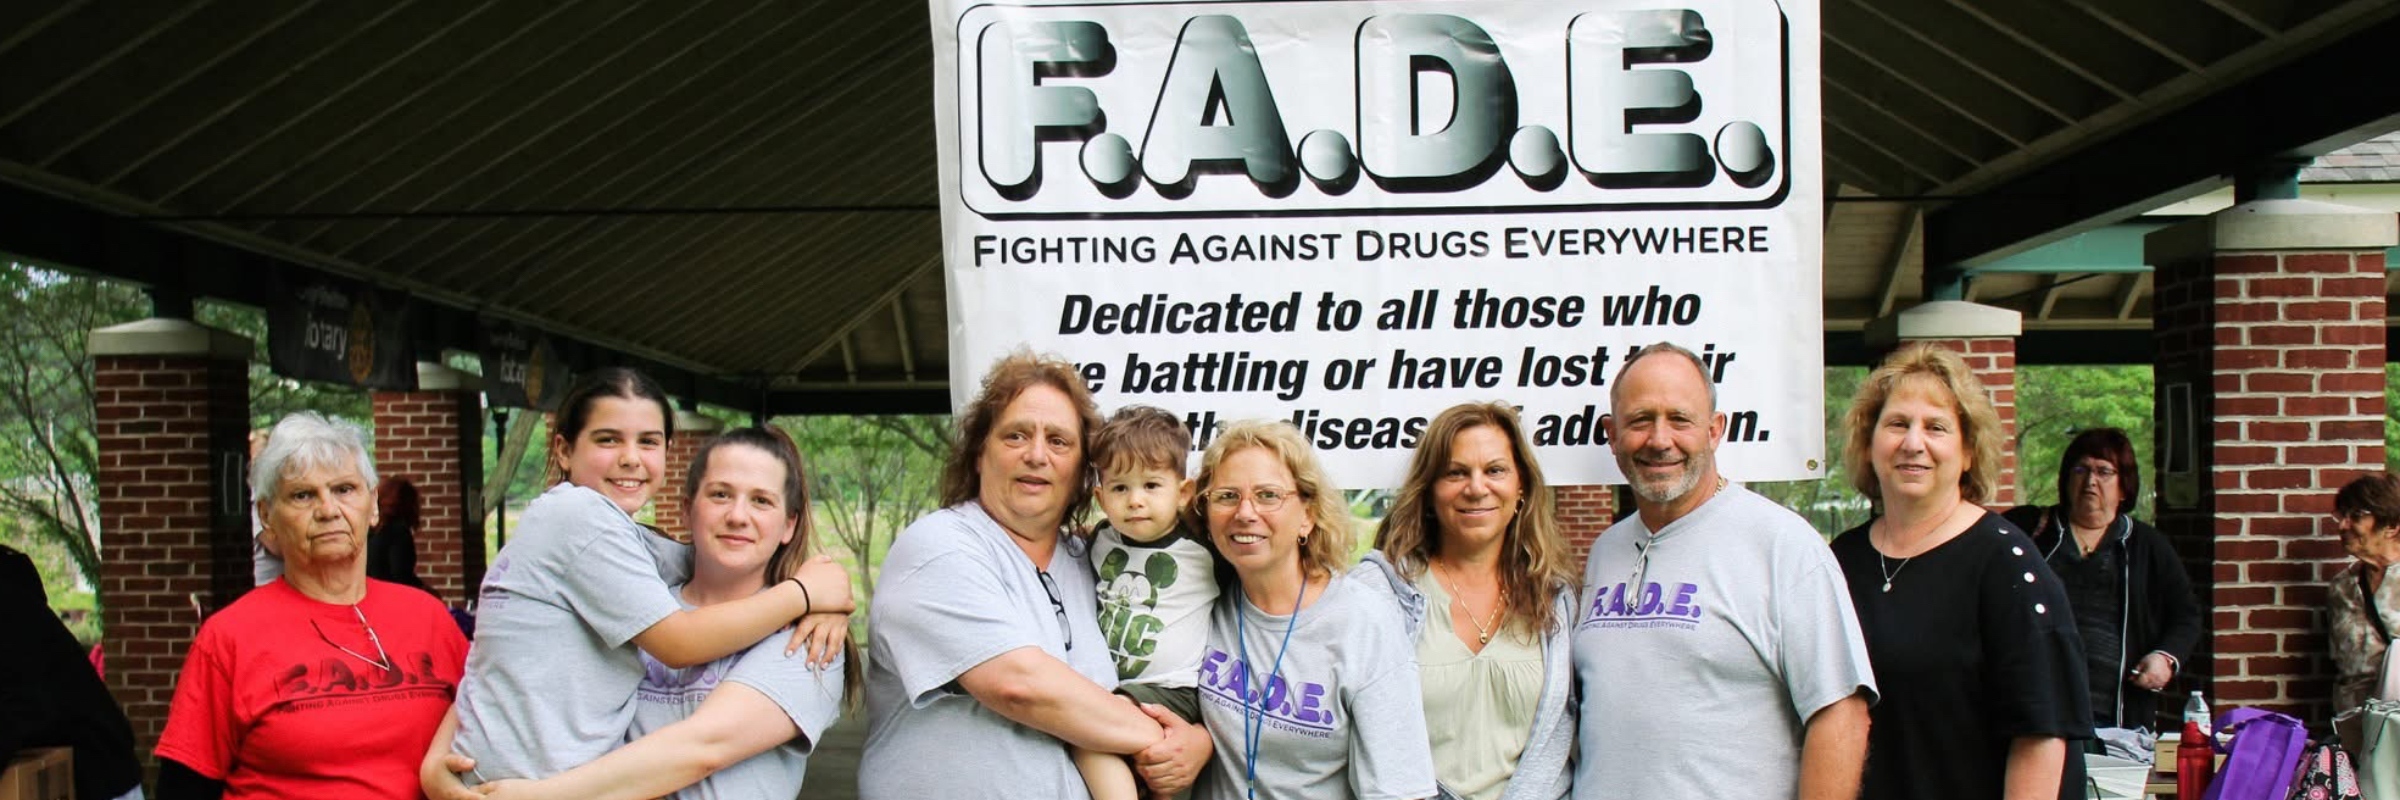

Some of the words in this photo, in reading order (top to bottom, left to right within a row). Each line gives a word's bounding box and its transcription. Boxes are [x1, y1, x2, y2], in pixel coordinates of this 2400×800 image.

[976, 9, 1775, 201] F.A.D.E.
[974, 235, 1156, 267] FIGHTING
[1170, 232, 1342, 265] AGAINST
[1356, 229, 1490, 262] DRUGS
[1504, 226, 1769, 259] EVERYWHERE
[1058, 291, 1302, 334] Dedicated
[1316, 291, 1363, 331] to
[1377, 289, 1438, 330] all
[1453, 288, 1585, 329] those
[1603, 285, 1701, 326] who
[1121, 352, 1309, 401] battling
[1323, 357, 1377, 391] or
[1388, 348, 1502, 389] have
[1516, 346, 1609, 387] lost
[1280, 409, 1428, 450] iseas
